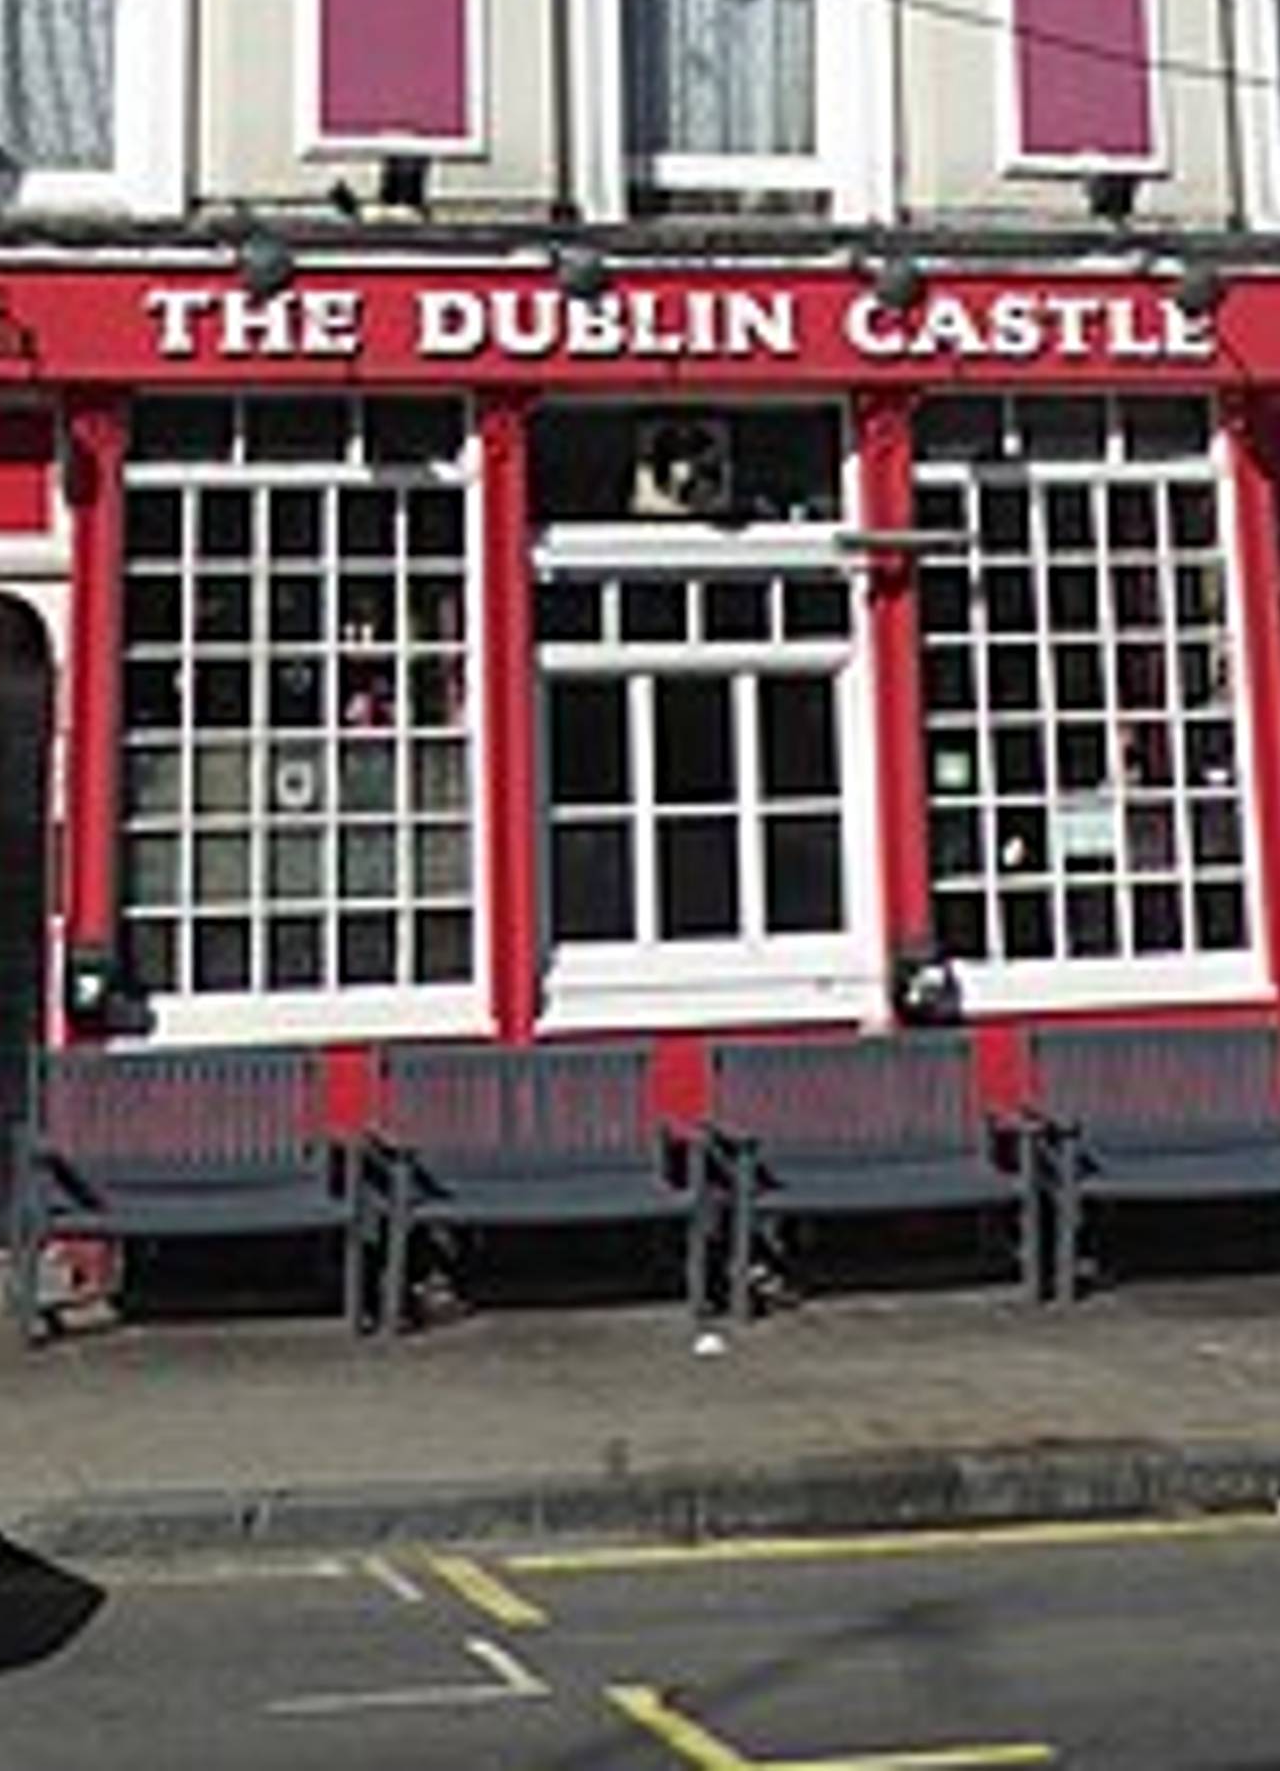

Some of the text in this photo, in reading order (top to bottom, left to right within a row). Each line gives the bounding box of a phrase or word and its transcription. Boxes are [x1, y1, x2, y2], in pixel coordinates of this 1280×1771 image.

[144, 286, 1216, 359] THE DUBLIN CASTLE
